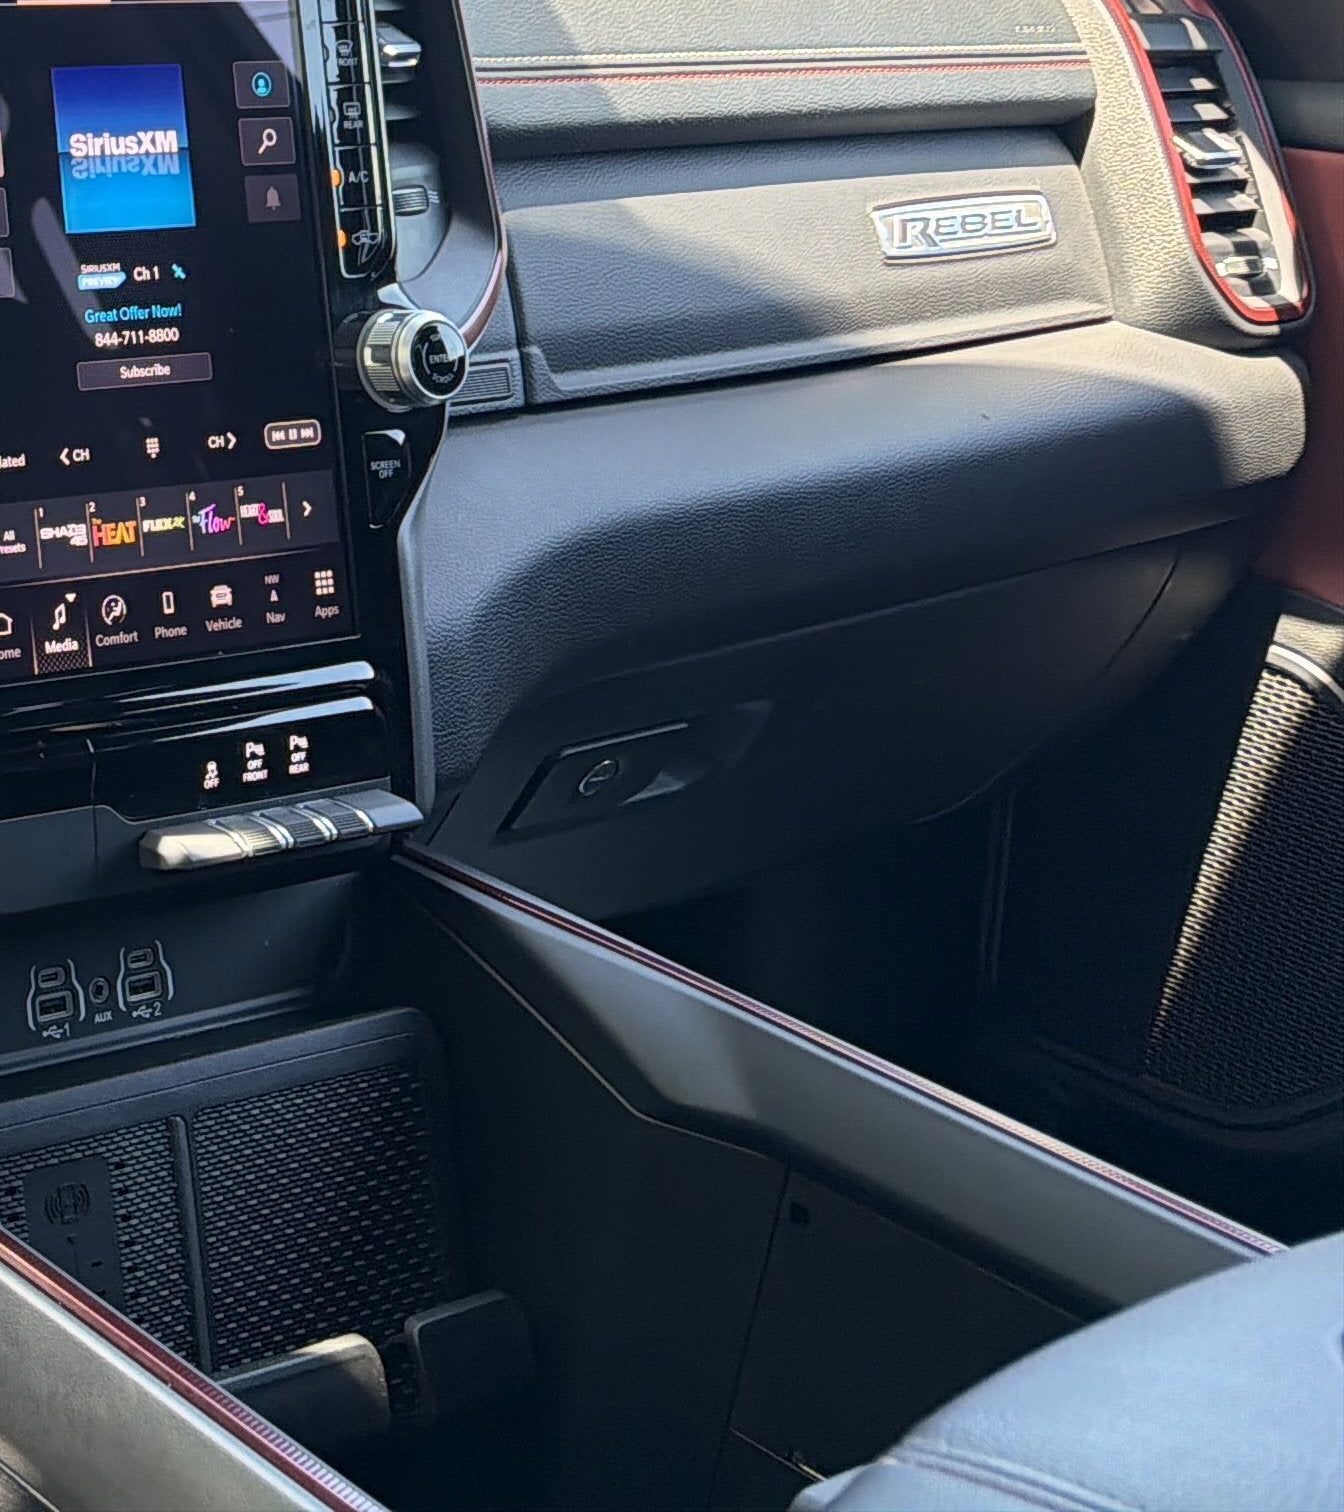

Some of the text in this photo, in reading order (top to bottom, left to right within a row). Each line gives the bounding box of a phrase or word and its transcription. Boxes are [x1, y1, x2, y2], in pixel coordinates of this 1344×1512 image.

[69, 130, 179, 156] SiriusXM
[348, 171, 370, 185] A/C
[892, 208, 1040, 249] REBEL
[133, 265, 160, 282] Ch 1
[84, 303, 182, 324] Great Offer Now!
[94, 327, 180, 348] 844-711-8800
[429, 353, 451, 365] ENTE
[119, 363, 171, 379] Subscribe
[207, 435, 225, 449] CH
[72, 448, 91, 462] CH
[370, 459, 401, 471] SCREEN
[378, 470, 394, 480] OFF
[88, 501, 96, 512] 2
[92, 520, 137, 548] HEAT
[265, 611, 286, 624] Nav
[314, 604, 340, 619] Apps
[154, 625, 188, 639] Phone
[205, 616, 243, 633] Vehicle
[44, 637, 80, 655] Media
[95, 630, 140, 647] Comfort
[94, 1010, 113, 1024] AUX
